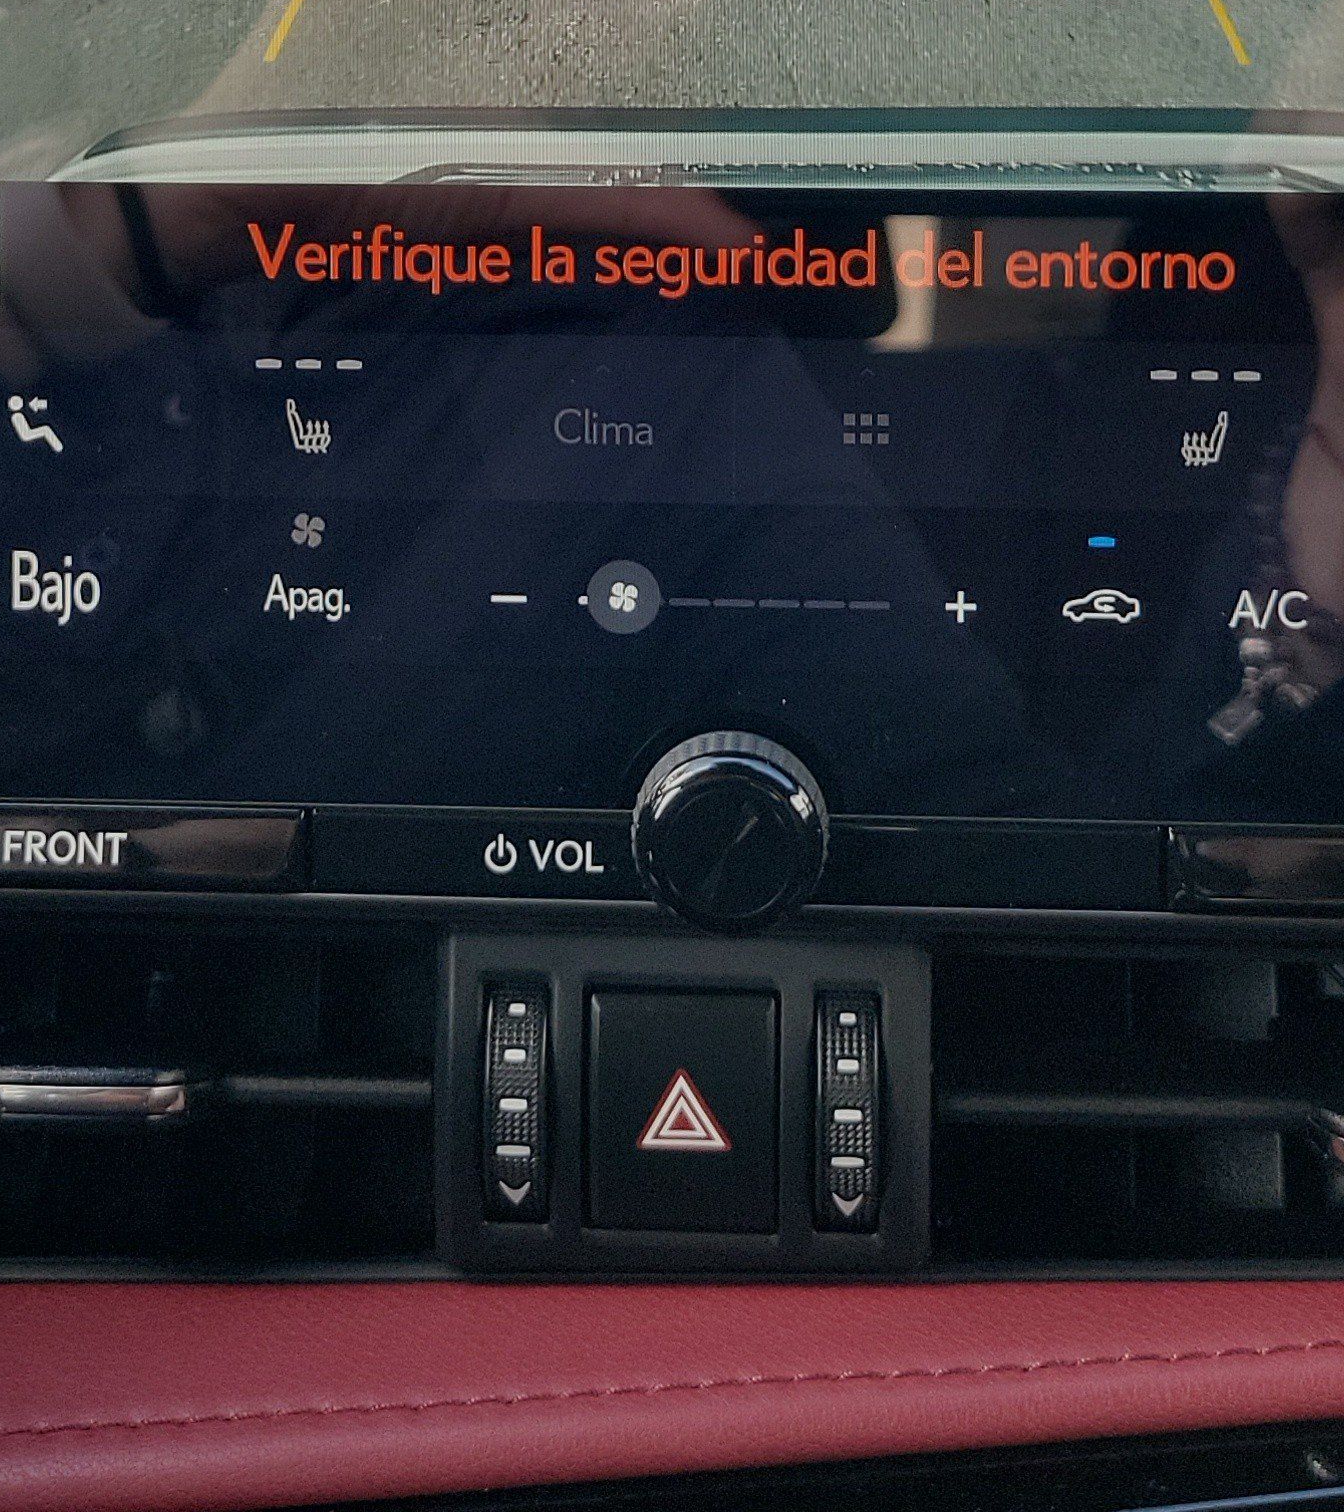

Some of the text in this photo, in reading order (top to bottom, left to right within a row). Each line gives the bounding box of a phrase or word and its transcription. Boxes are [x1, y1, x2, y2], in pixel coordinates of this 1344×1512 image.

[247, 223, 1236, 298] Verifique la seguridad del entorno
[554, 408, 653, 445] Clima
[10, 550, 101, 626] Bajo
[263, 574, 351, 621] Apag.
[1228, 589, 1310, 631] A/C
[1, 830, 127, 867] FRONT
[528, 840, 605, 875] VOL
